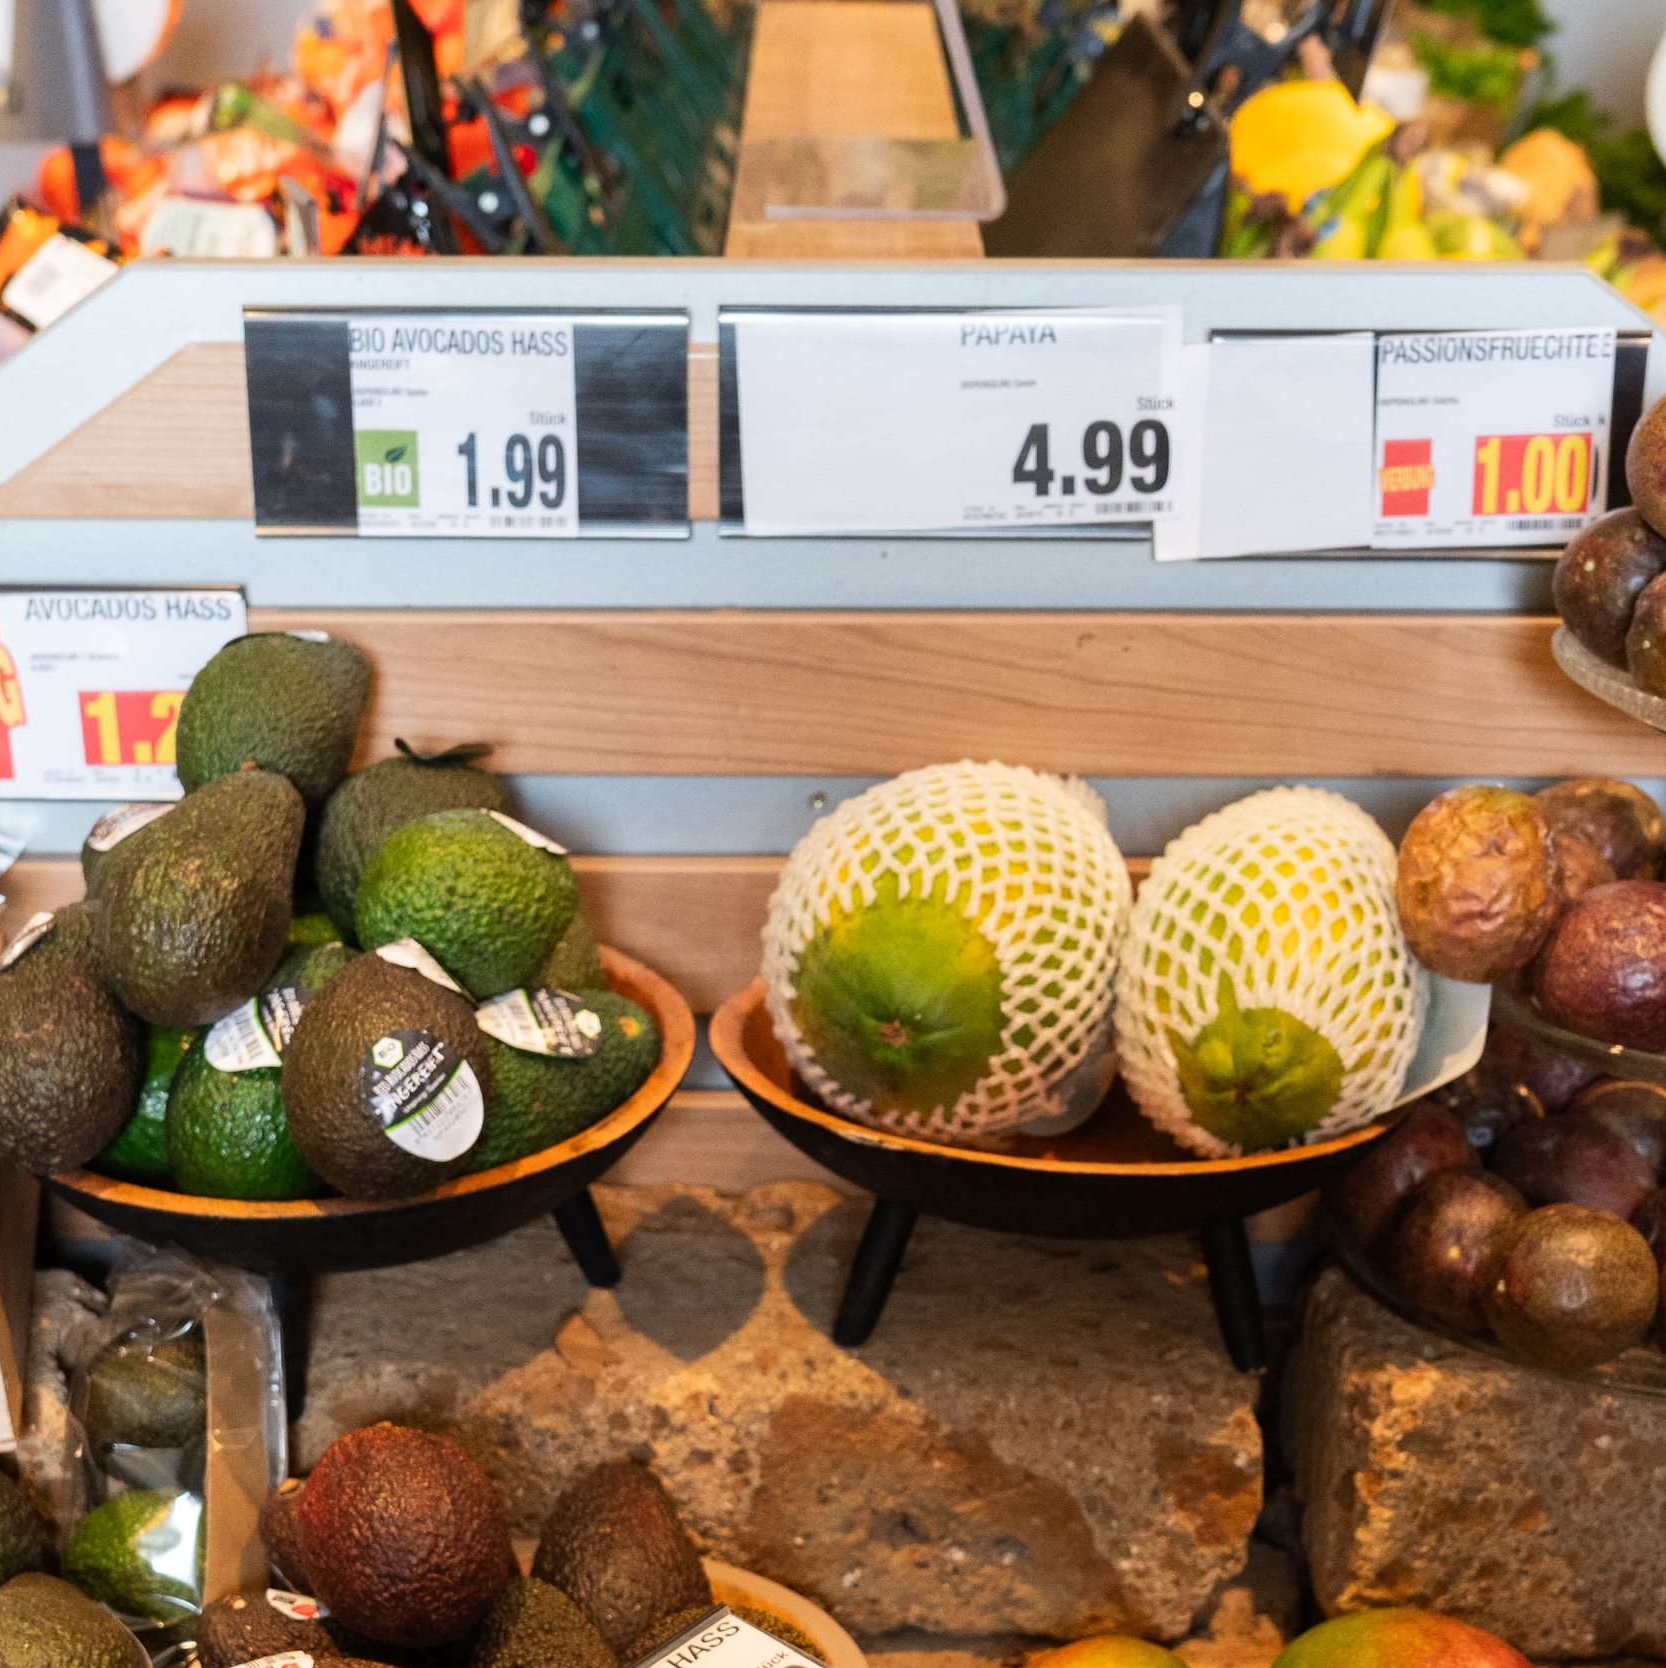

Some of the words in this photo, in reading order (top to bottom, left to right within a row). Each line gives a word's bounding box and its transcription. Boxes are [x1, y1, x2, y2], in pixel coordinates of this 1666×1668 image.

[351, 328, 384, 353] BIO
[392, 328, 505, 355] AVOCADOS
[511, 330, 568, 356] HASS
[960, 323, 1057, 346] PAPAYA
[1382, 332, 1598, 365] PASSIONSFRUECHTE
[529, 411, 568, 426] Stück
[1553, 413, 1590, 429] Stück
[457, 431, 566, 509] 1.99
[1013, 418, 1171, 497] 4.99
[363, 462, 413, 496] BIO
[1477, 434, 1589, 515] 1.00
[25, 597, 158, 622] AVOCADOS
[165, 597, 233, 621] HASS
[85, 692, 185, 765] 1.2
